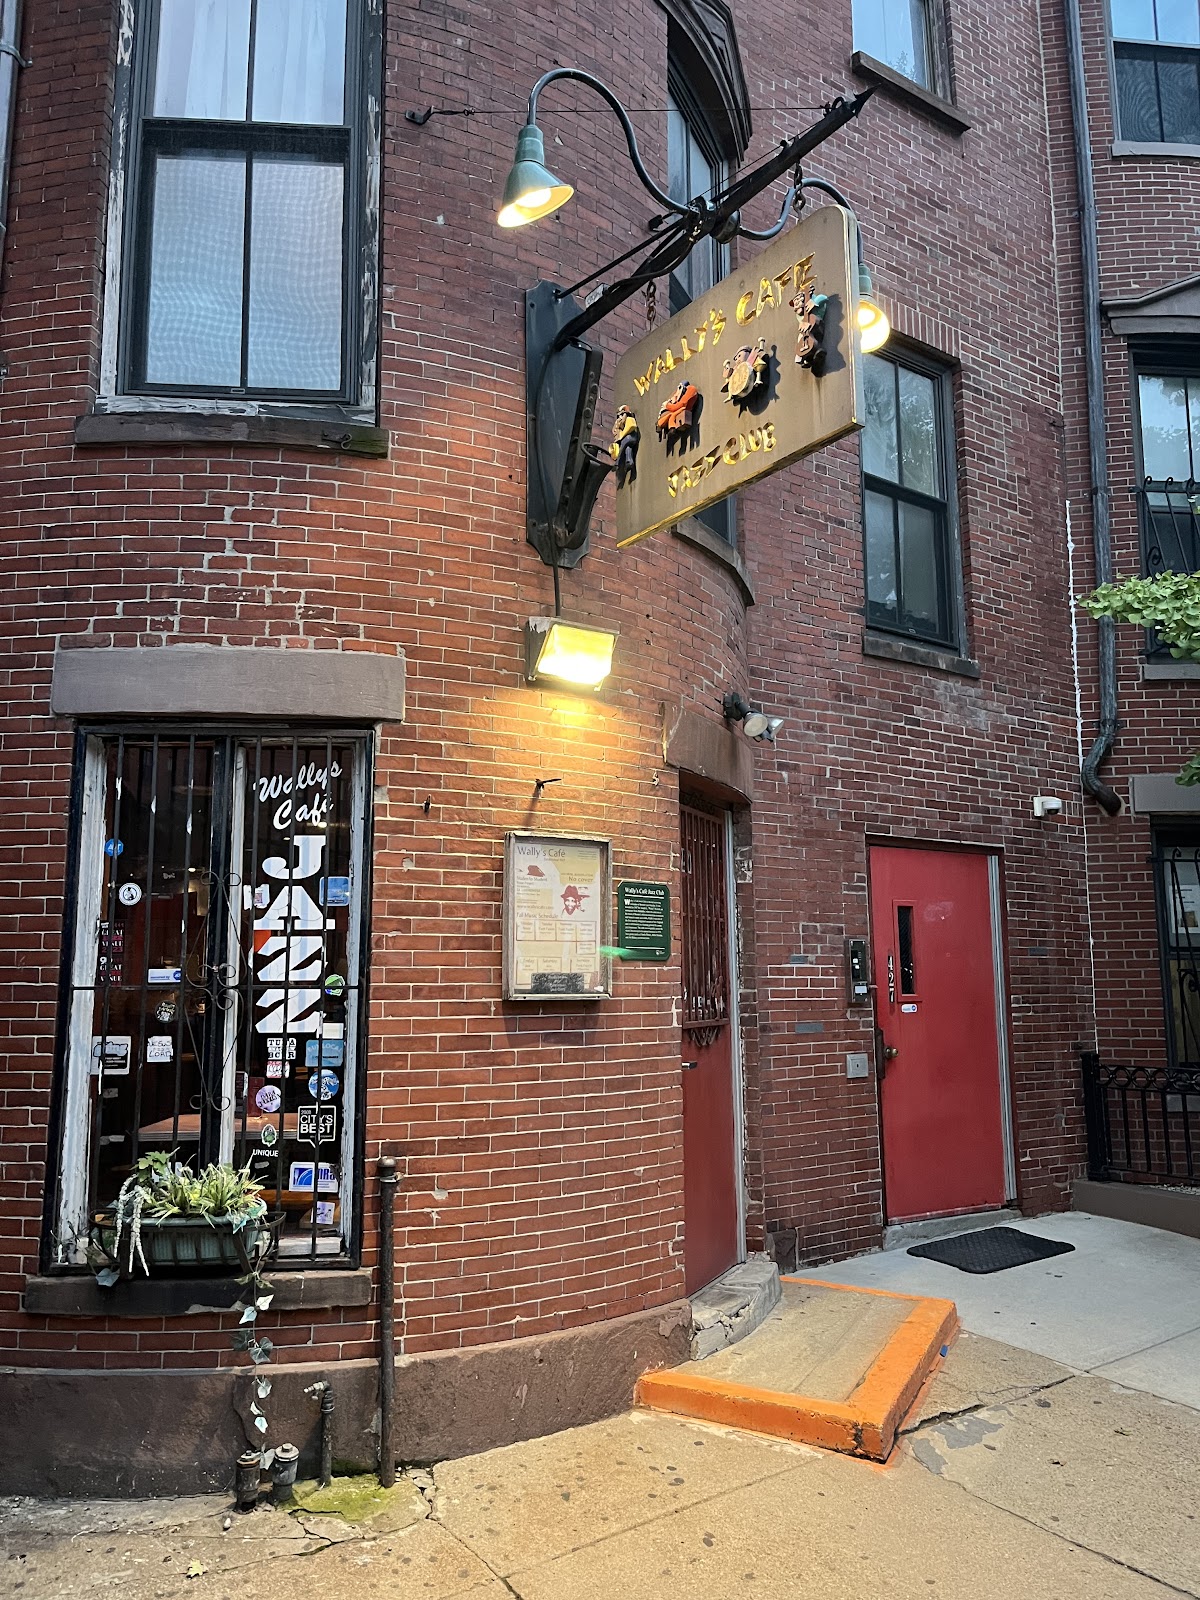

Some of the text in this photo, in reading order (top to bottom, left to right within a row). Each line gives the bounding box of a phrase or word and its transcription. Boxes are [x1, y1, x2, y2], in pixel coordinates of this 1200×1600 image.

[633, 251, 818, 397] WALLY'S CAFE
[722, 421, 777, 465] CLUB
[107, 843, 122, 852] AT
[517, 845, 547, 858] Wally's
[548, 848, 566, 858] Café
[253, 835, 336, 1034] JAZZ
[300, 1114, 334, 1124] CITY'S
[300, 1123, 334, 1134] BEST
[252, 1148, 279, 1157] UNIQUE
